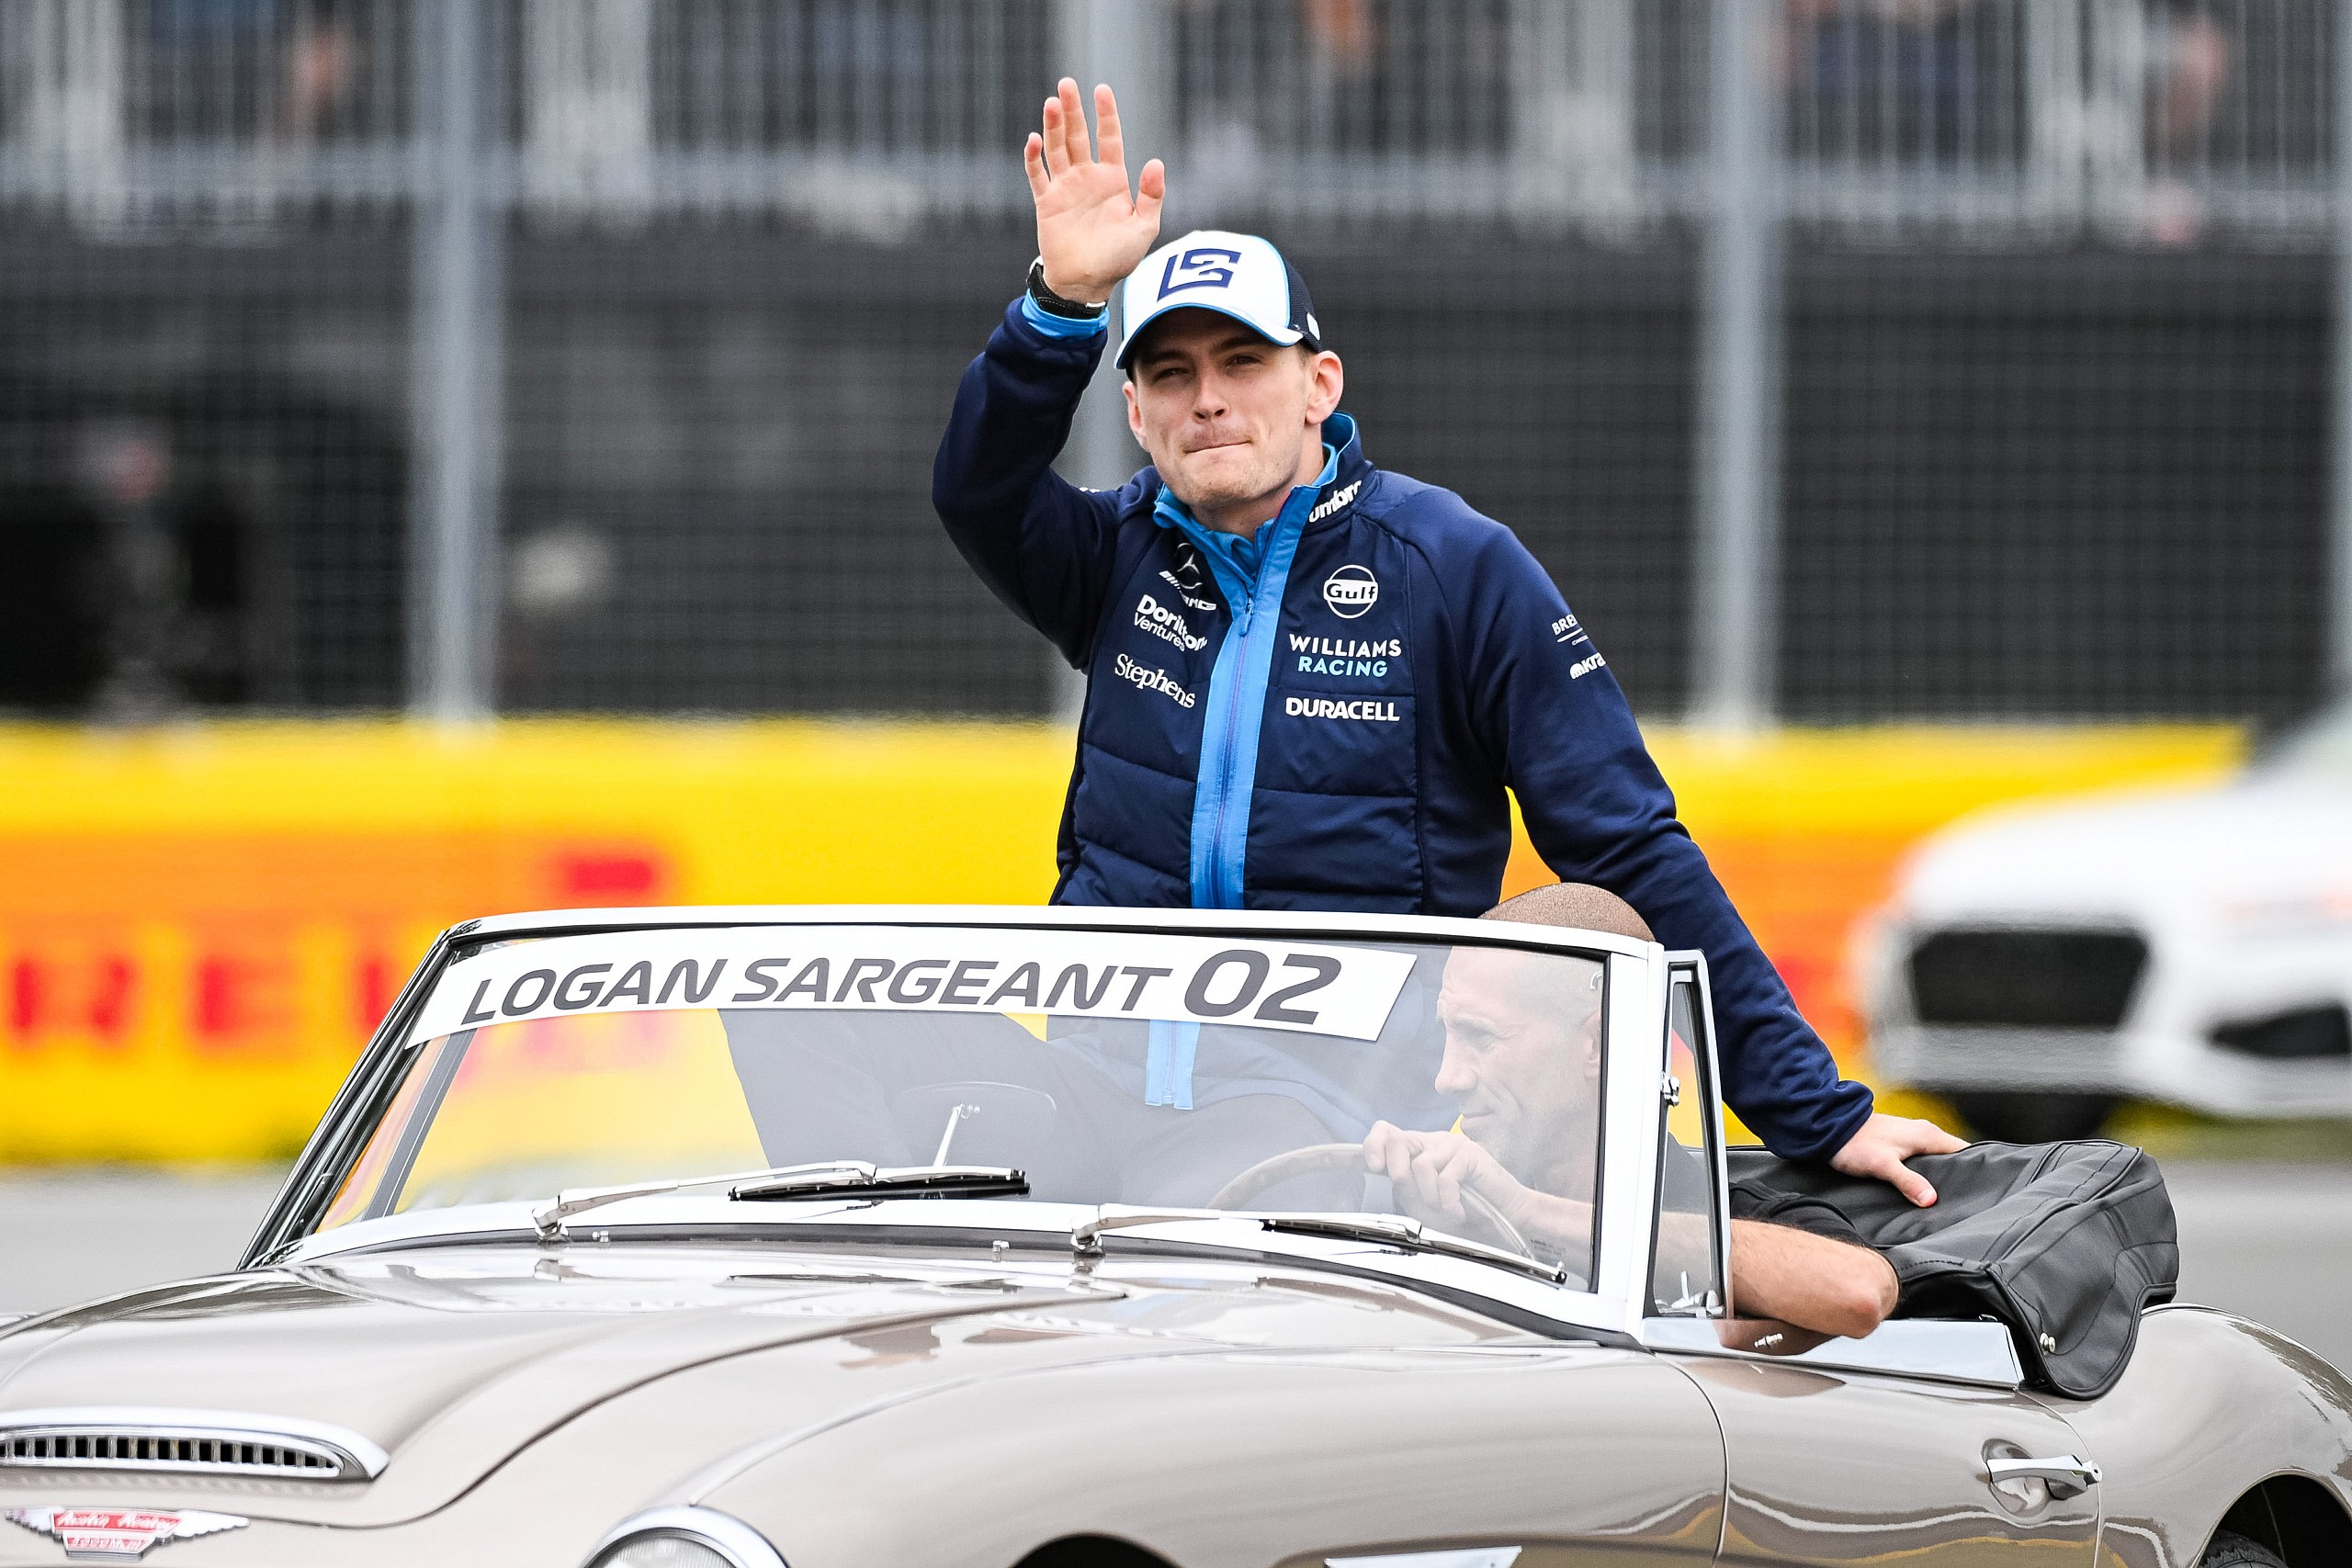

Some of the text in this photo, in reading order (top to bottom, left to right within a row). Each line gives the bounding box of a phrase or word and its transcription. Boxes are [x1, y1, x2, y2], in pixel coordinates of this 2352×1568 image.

[1326, 583, 1376, 600] Gulf
[1134, 612, 1186, 651] Ventures
[1289, 633, 1402, 658] WILLIAMS
[1297, 656, 1388, 677] RACING
[1114, 653, 1196, 708] Stephens
[1285, 696, 1401, 722] DURACELL
[460, 949, 1342, 1026] LOGAN SARGEANT 02
